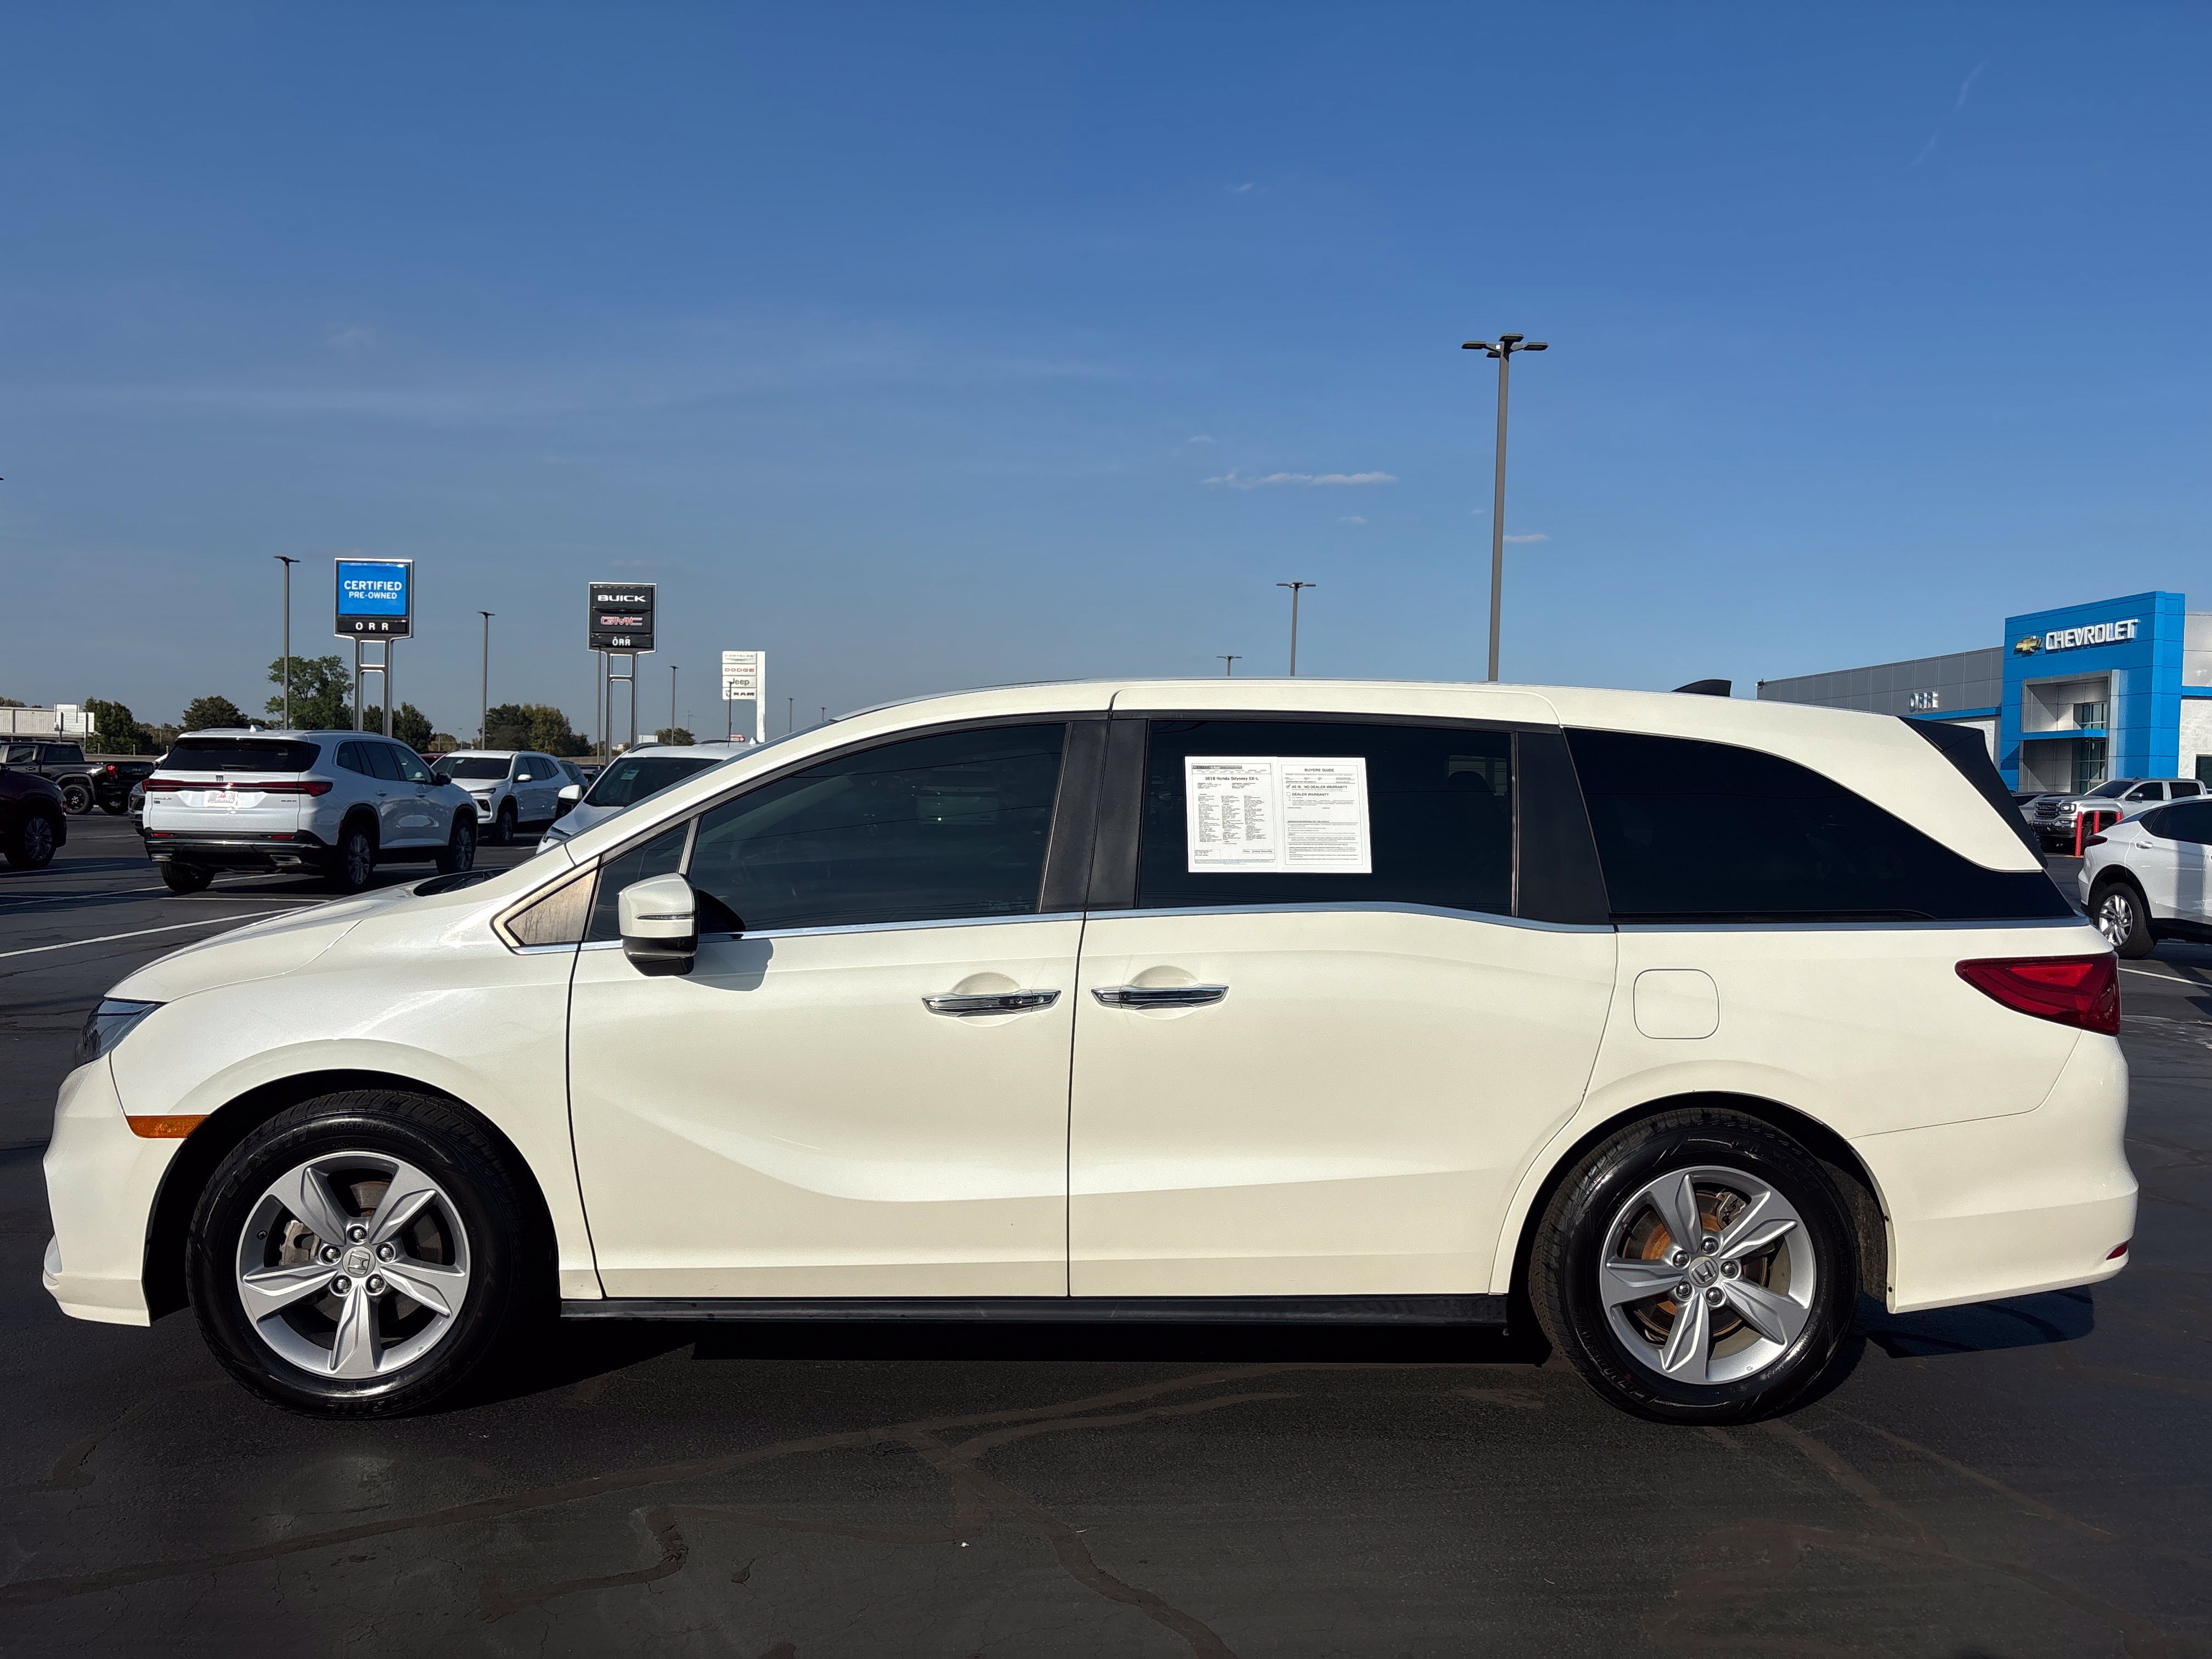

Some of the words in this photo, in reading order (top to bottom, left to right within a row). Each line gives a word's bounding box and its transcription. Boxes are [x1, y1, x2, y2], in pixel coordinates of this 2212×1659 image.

[344, 580, 402, 591] CERTIFIED
[601, 616, 643, 625] GMC
[355, 622, 389, 631] ORR
[2045, 619, 2140, 650] CHEVROLET
[612, 638, 631, 646] ORR
[731, 678, 750, 686] Jeep
[331, 1122, 407, 1138] ROADBLAZER
